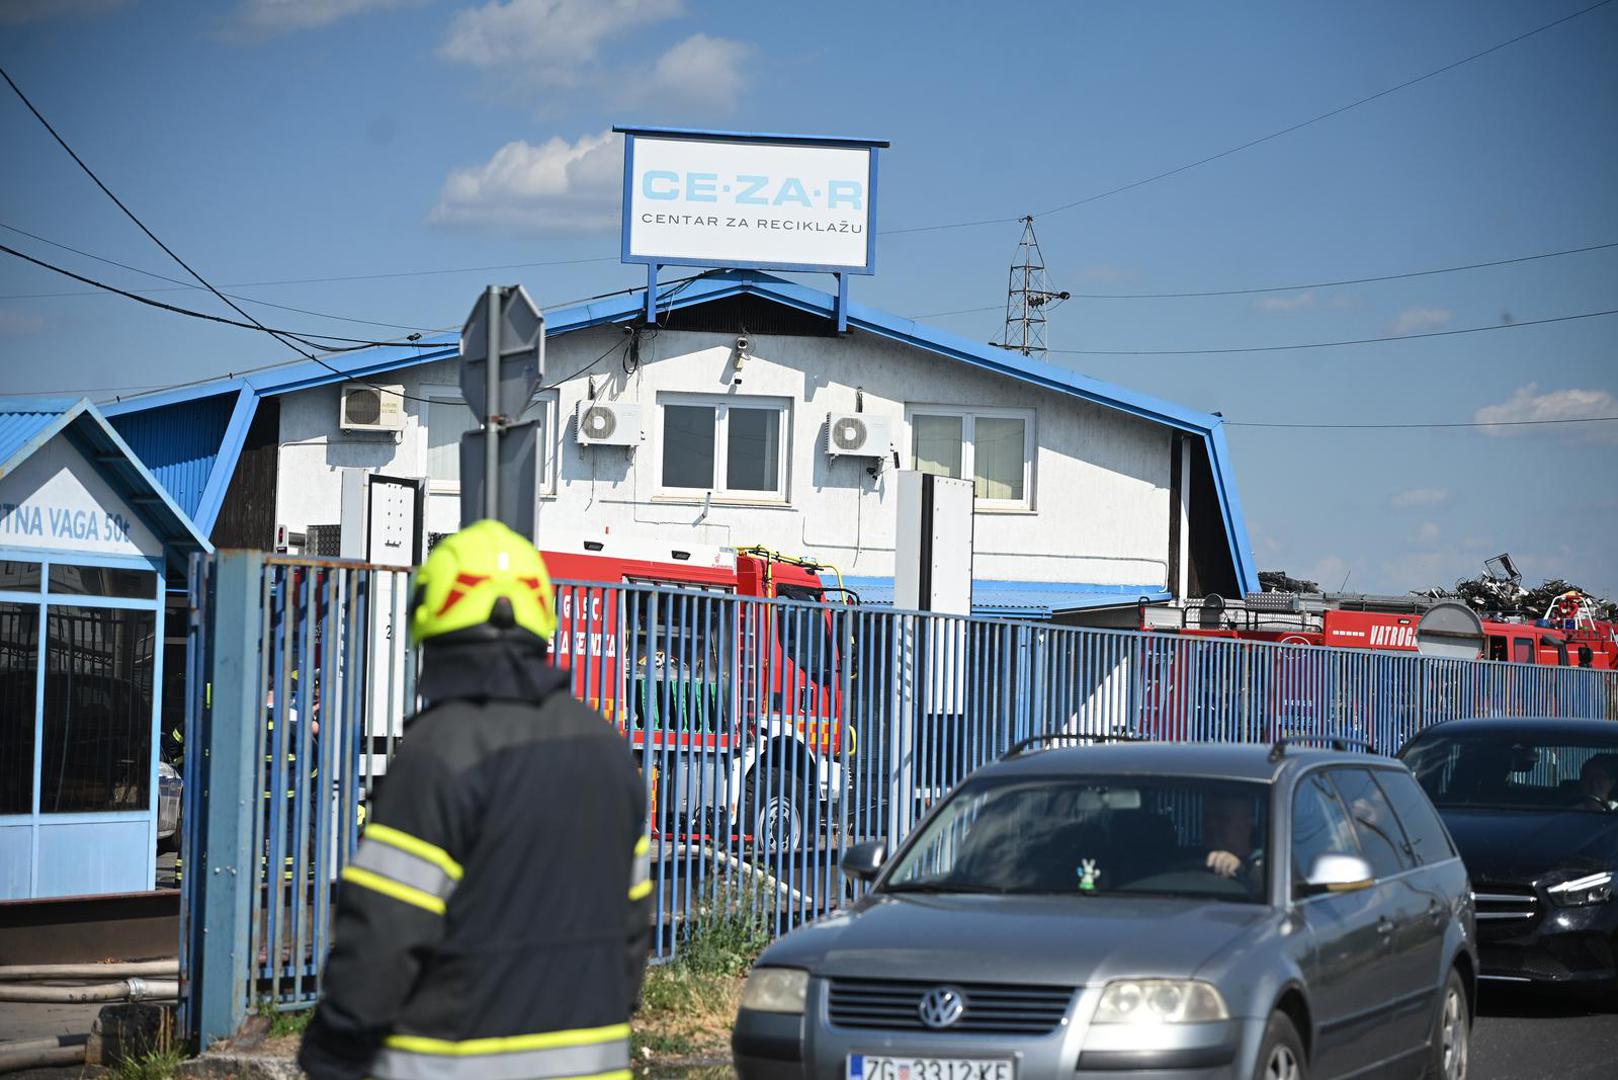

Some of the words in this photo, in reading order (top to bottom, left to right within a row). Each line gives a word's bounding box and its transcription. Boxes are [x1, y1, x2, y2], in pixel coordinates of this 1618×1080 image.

[641, 213, 718, 226] CENTAR
[726, 217, 749, 228] ZA
[757, 219, 862, 234] RECIKLAŽU
[0, 503, 43, 536] TNA
[49, 507, 99, 541] VAGA
[103, 512, 131, 543] 50t
